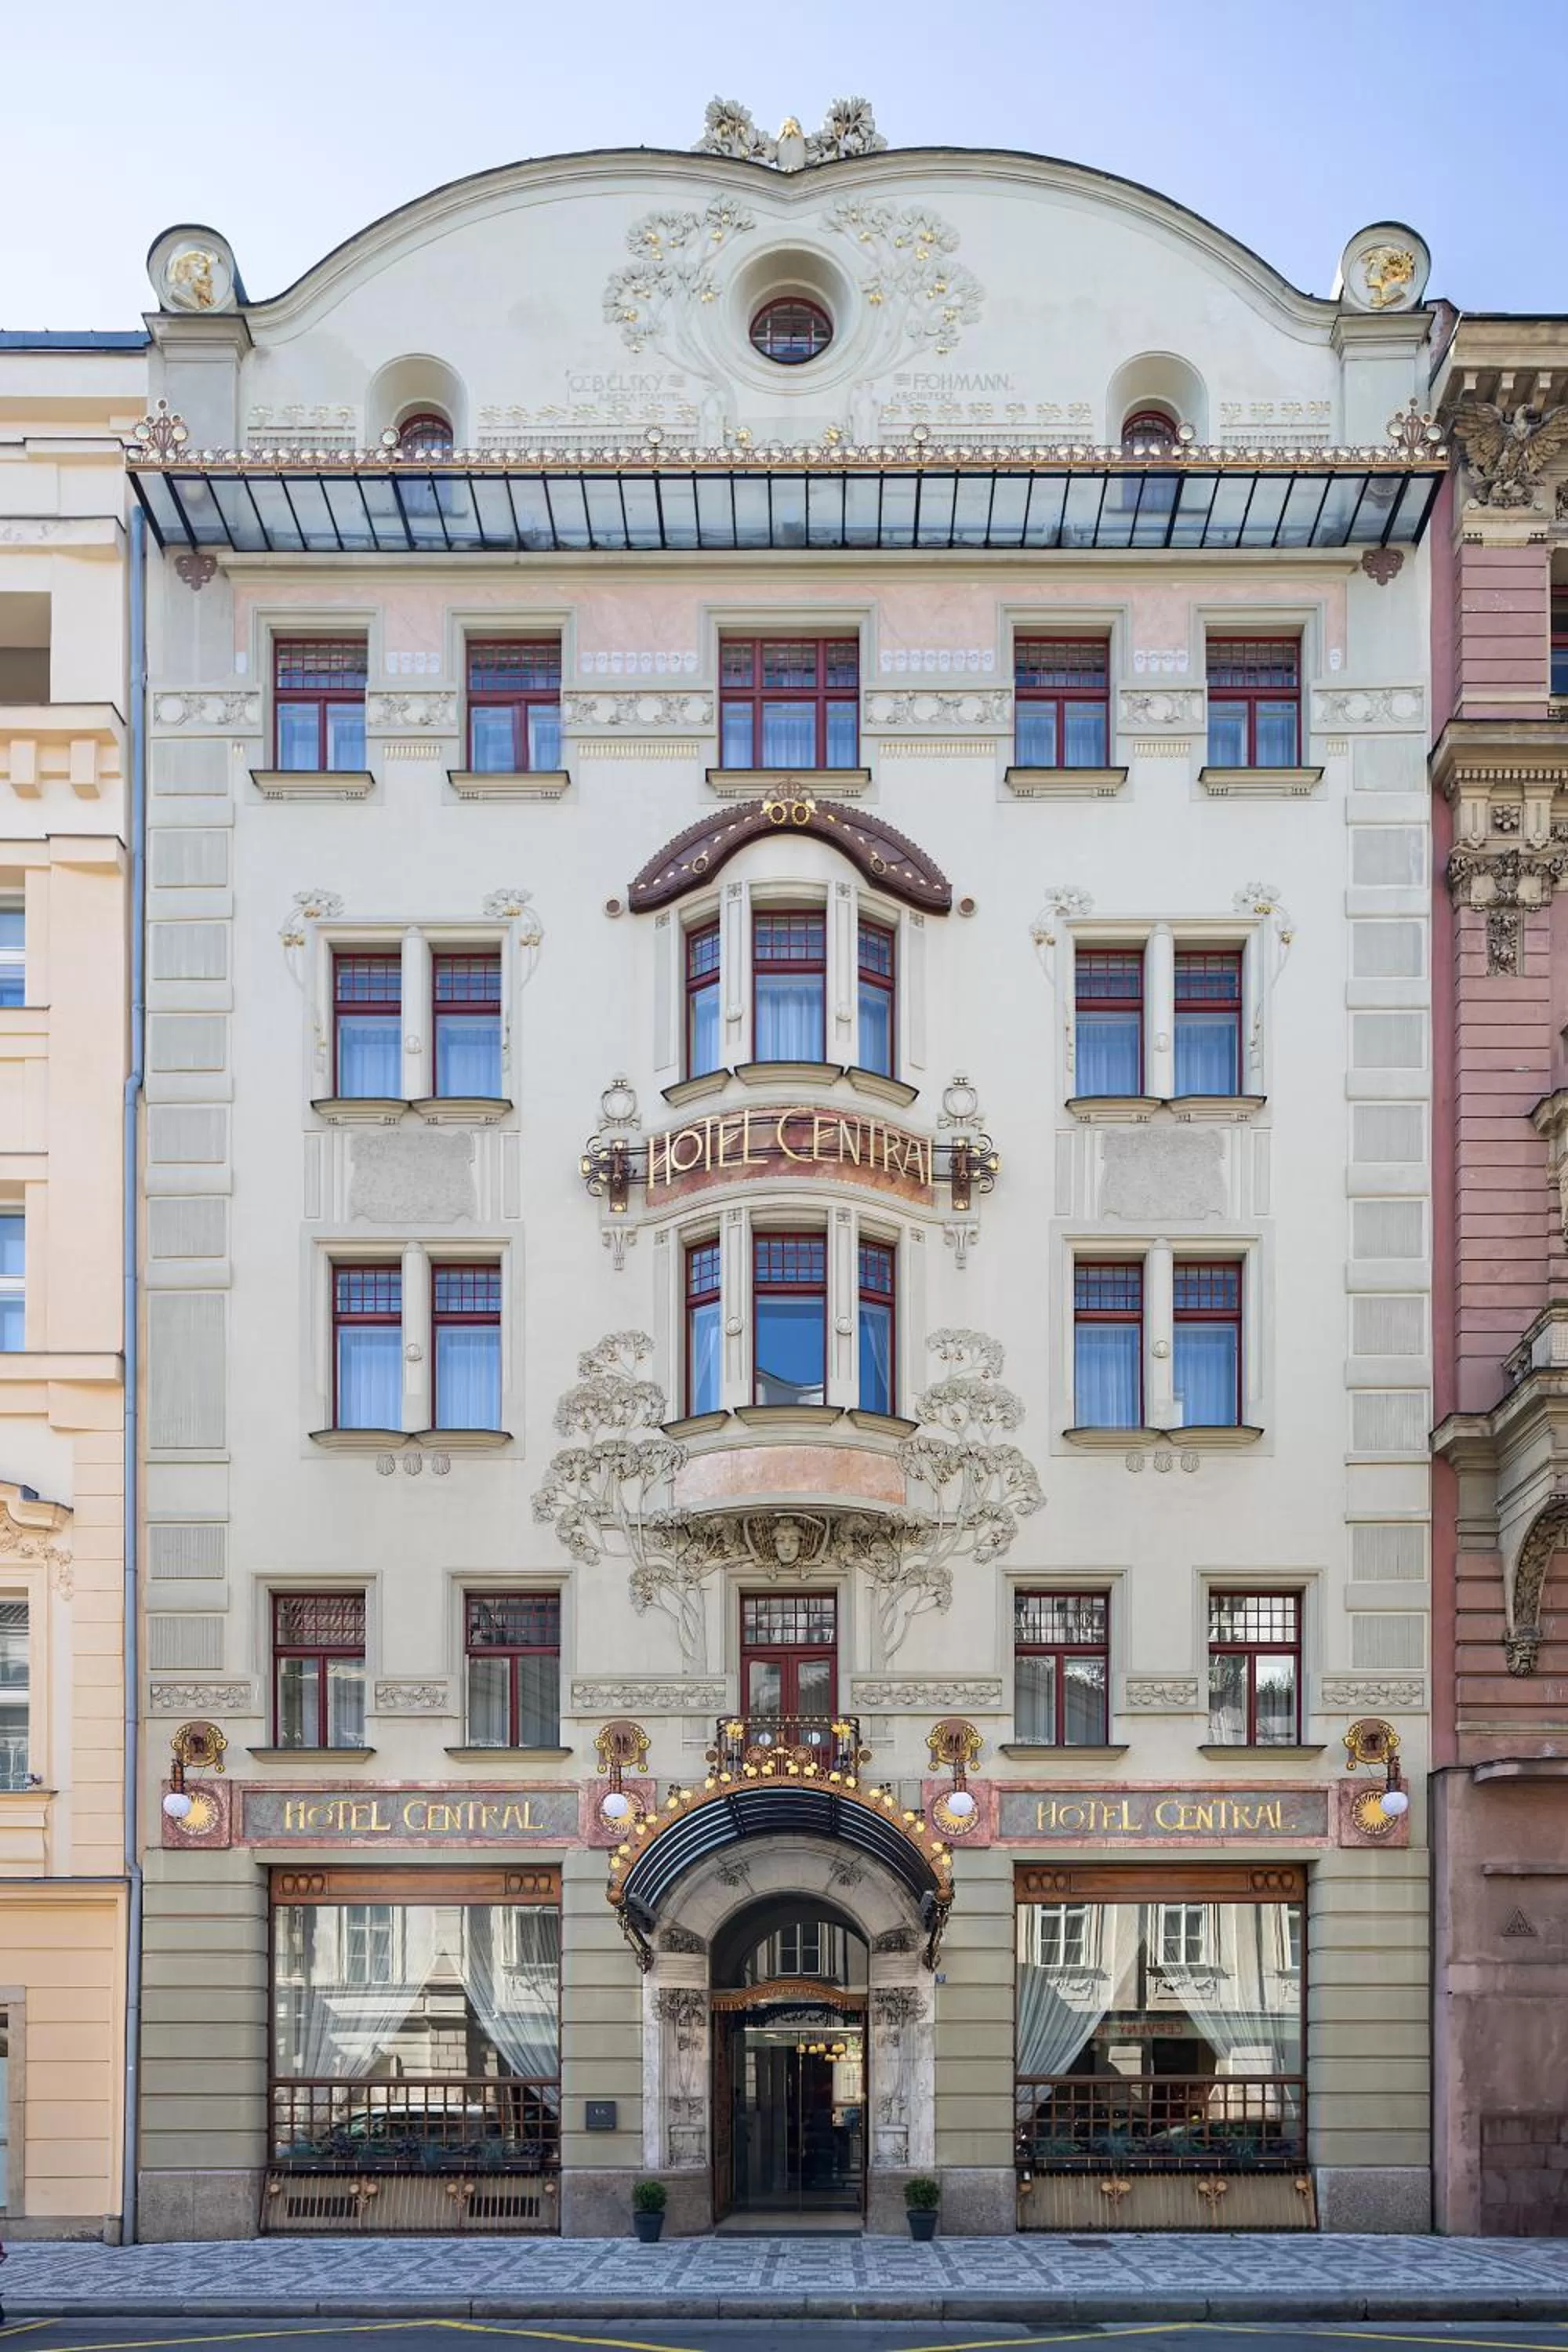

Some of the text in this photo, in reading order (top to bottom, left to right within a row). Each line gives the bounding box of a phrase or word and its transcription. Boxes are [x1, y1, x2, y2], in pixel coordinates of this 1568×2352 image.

[648, 1107, 952, 1189] HOTEL CENTRAL
[285, 1801, 543, 1831] HOTEL CENTRAL
[1036, 1800, 1142, 1831] HOTEL
